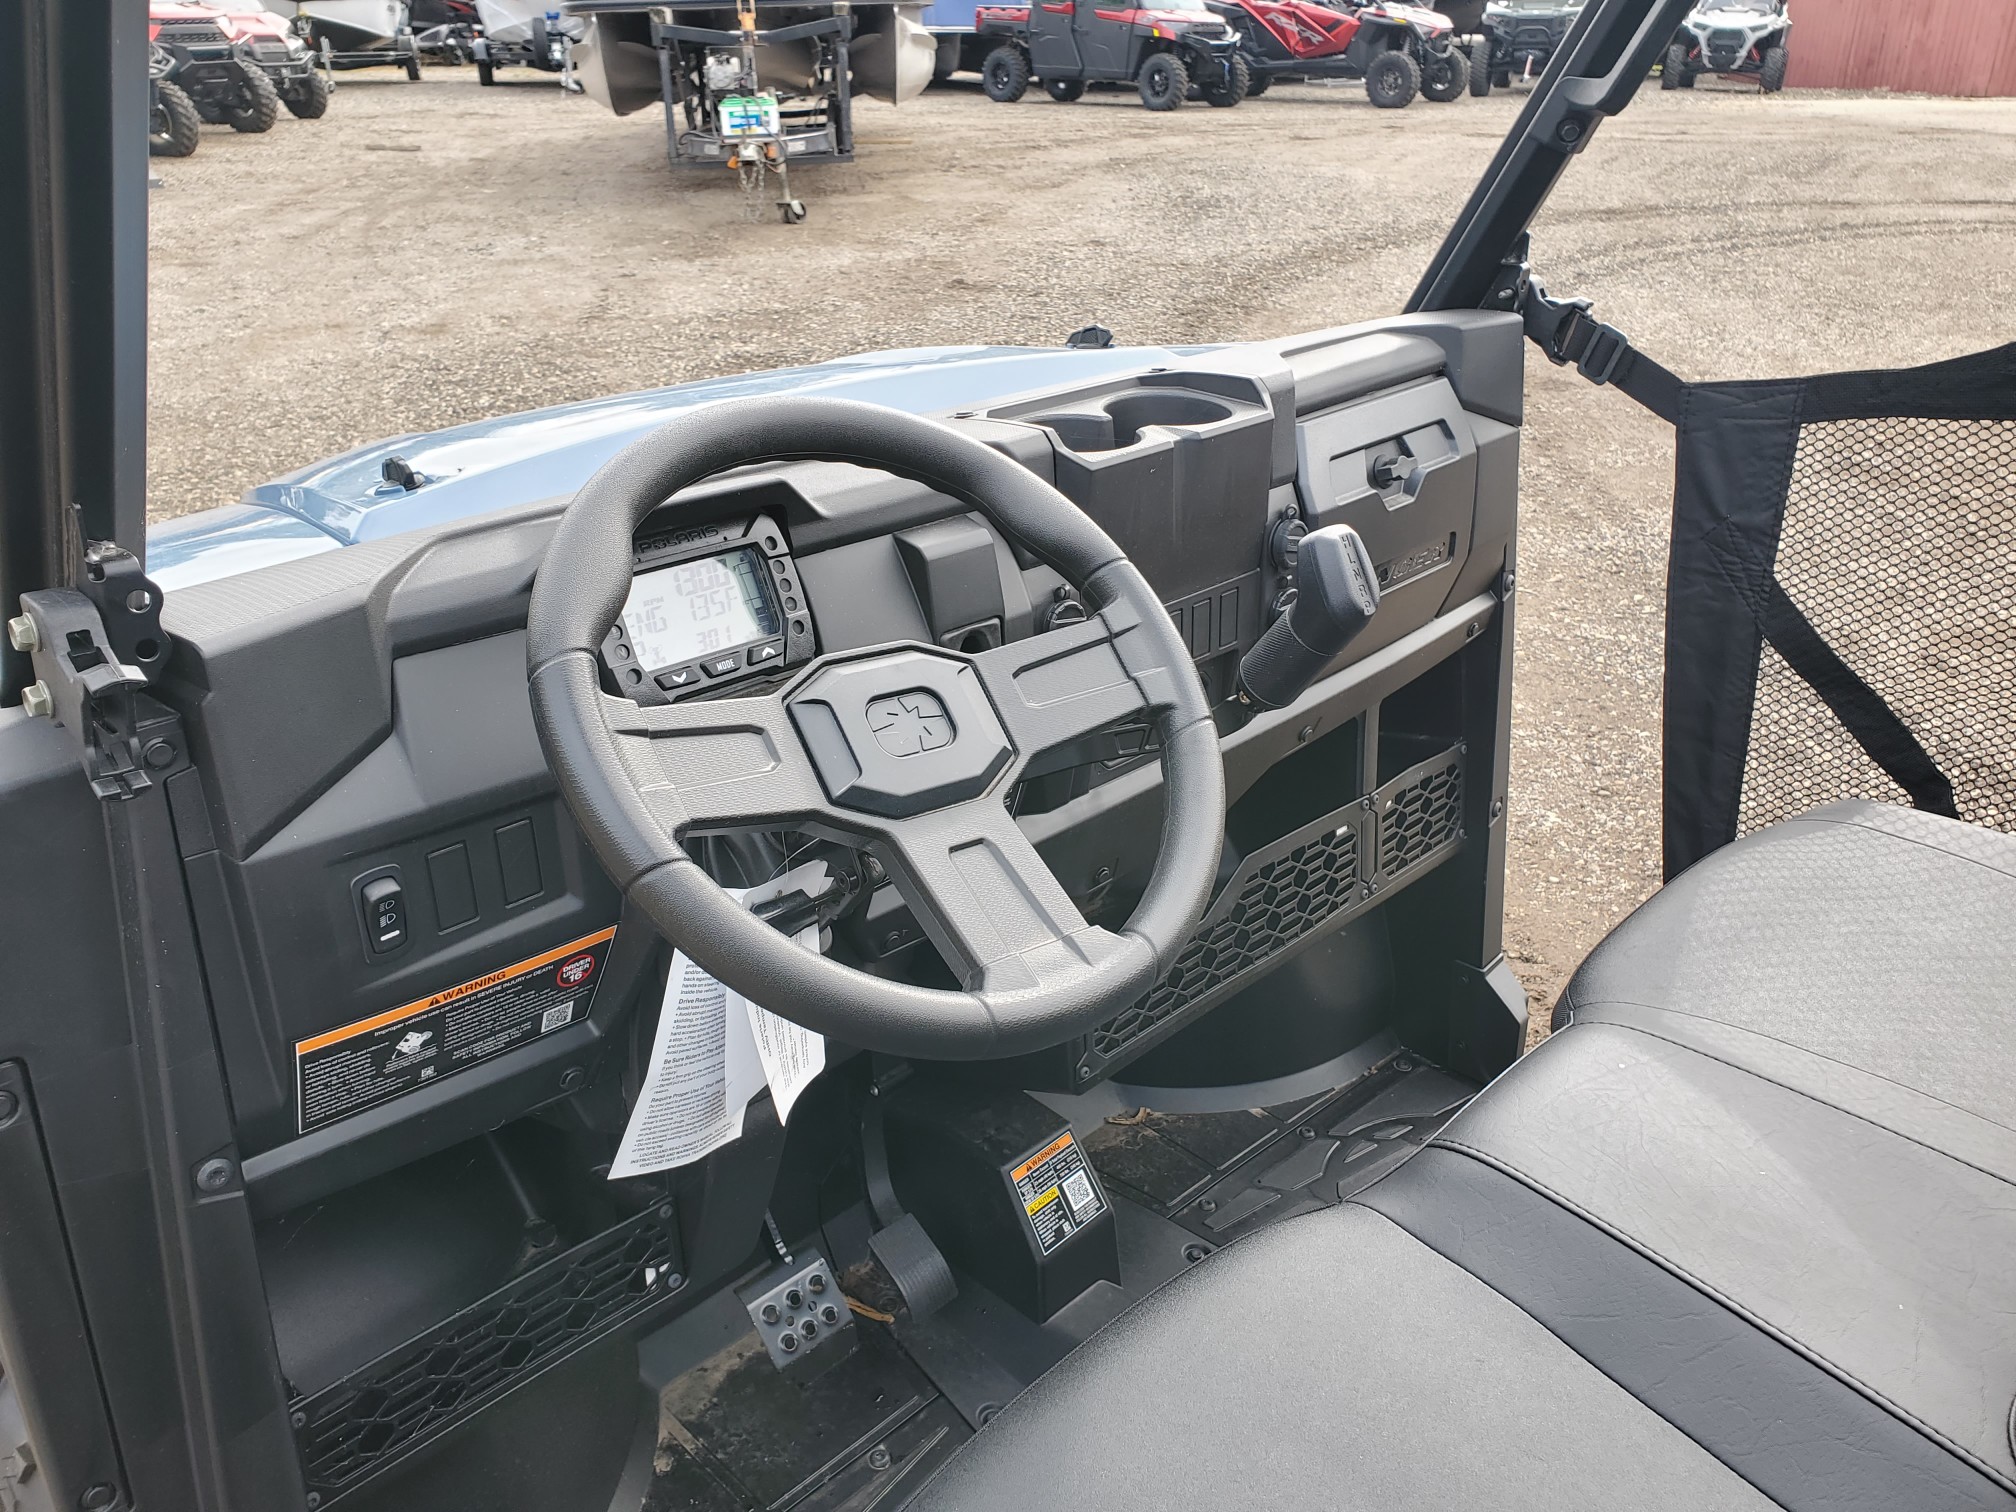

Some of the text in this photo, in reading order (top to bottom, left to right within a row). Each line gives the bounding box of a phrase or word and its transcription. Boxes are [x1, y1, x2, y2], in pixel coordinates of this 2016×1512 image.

[638, 526, 719, 553] POLARIS
[643, 596, 664, 607] RPM
[716, 658, 736, 672] MODE
[563, 957, 591, 973] DRIVER
[563, 964, 590, 978] UNDER
[568, 971, 583, 983] 16
[443, 971, 506, 1002] WARNING
[375, 1022, 404, 1037] Improper
[405, 1013, 427, 1025] vehicle
[453, 997, 471, 1008] result
[478, 984, 502, 998] SEVERE
[503, 976, 526, 988] INJURY
[534, 965, 554, 976] DEATH
[695, 993, 726, 1003] Responsibly
[650, 1095, 672, 1103] Require
[673, 1090, 690, 1098] Proper
[1031, 1143, 1061, 1166] WARNING
[1034, 1189, 1057, 1209] CAUTION
